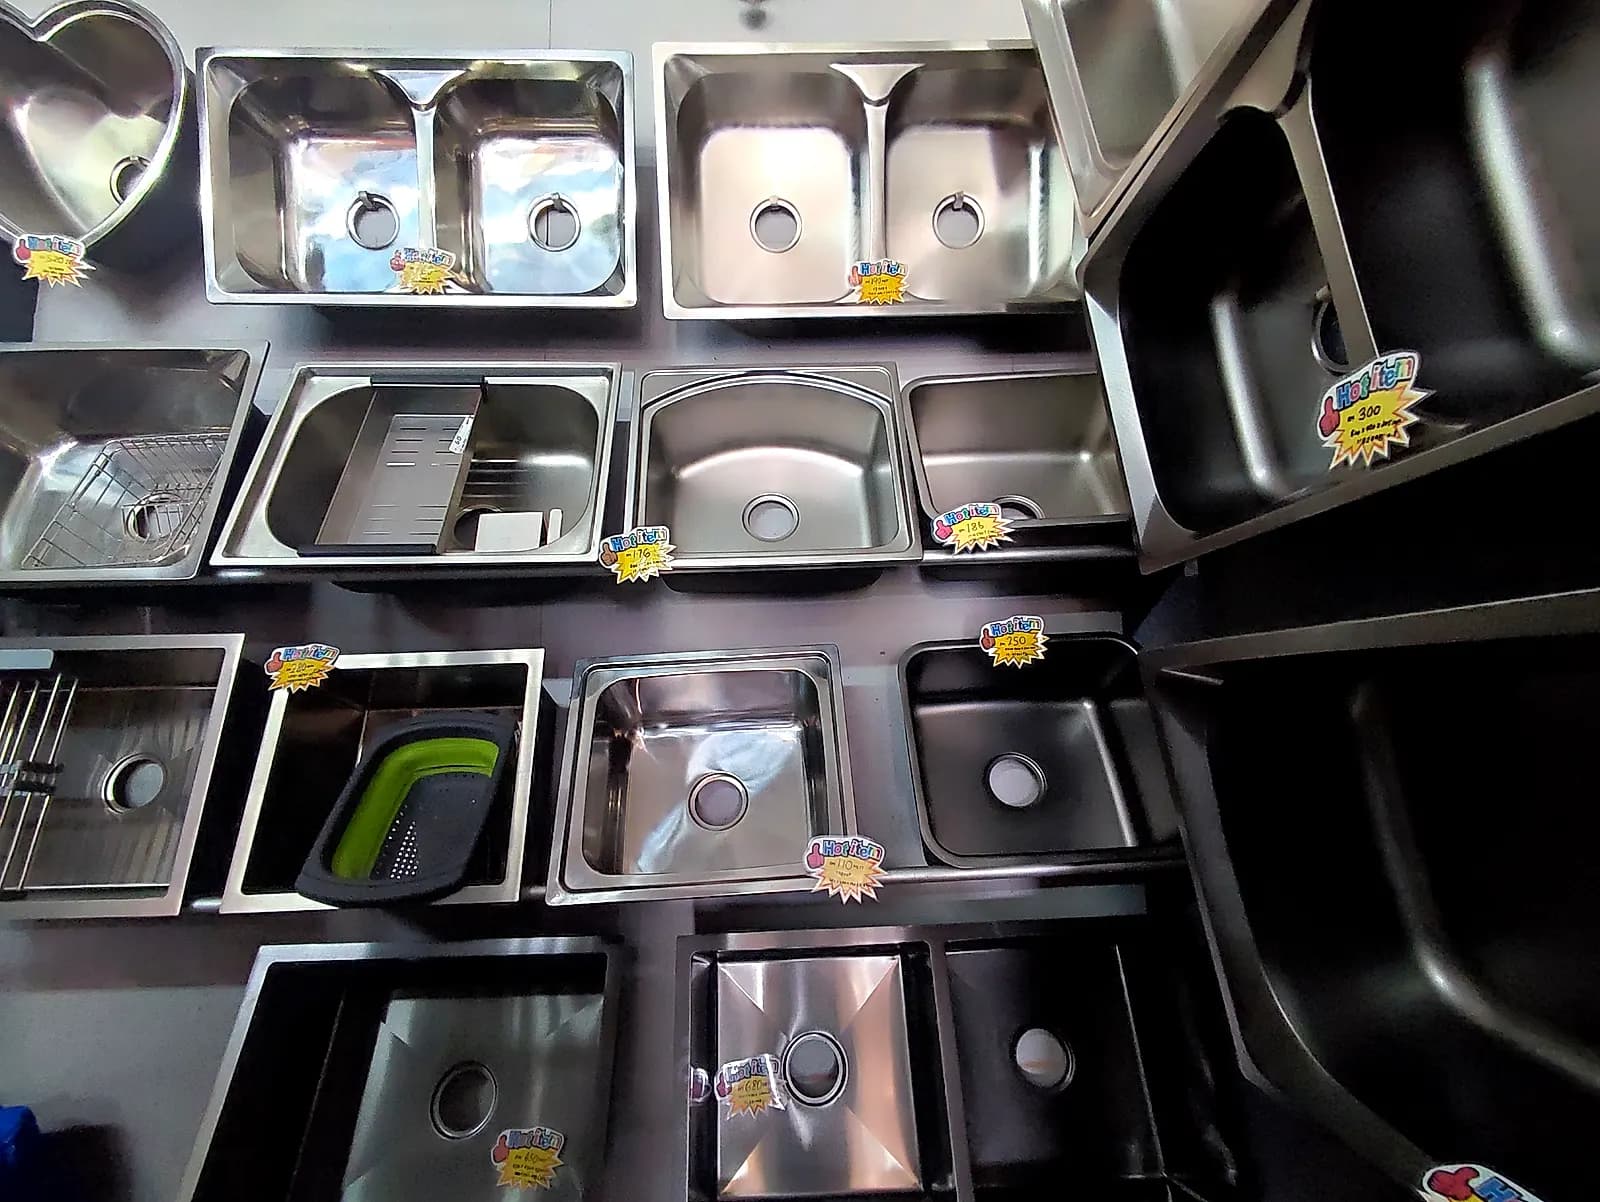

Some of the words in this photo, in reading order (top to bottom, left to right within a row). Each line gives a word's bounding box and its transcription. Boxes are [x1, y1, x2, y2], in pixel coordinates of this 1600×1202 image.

[28, 236, 52, 251] Hot
[860, 262, 881, 275] Hot
[881, 260, 907, 275] item
[1336, 372, 1370, 411] Hot
[1370, 356, 1415, 391] item
[1358, 405, 1381, 421] 300
[944, 508, 970, 525] Hot
[969, 503, 1000, 517] item
[610, 533, 637, 552] Hot
[636, 528, 668, 545] item
[633, 548, 651, 559] 176
[990, 621, 1013, 637] Hot
[1013, 617, 1041, 632] item
[283, 648, 308, 661] Hot
[308, 645, 338, 659] item
[823, 840, 849, 857] Hot
[849, 839, 882, 860] item
[533, 1128, 561, 1150] item
